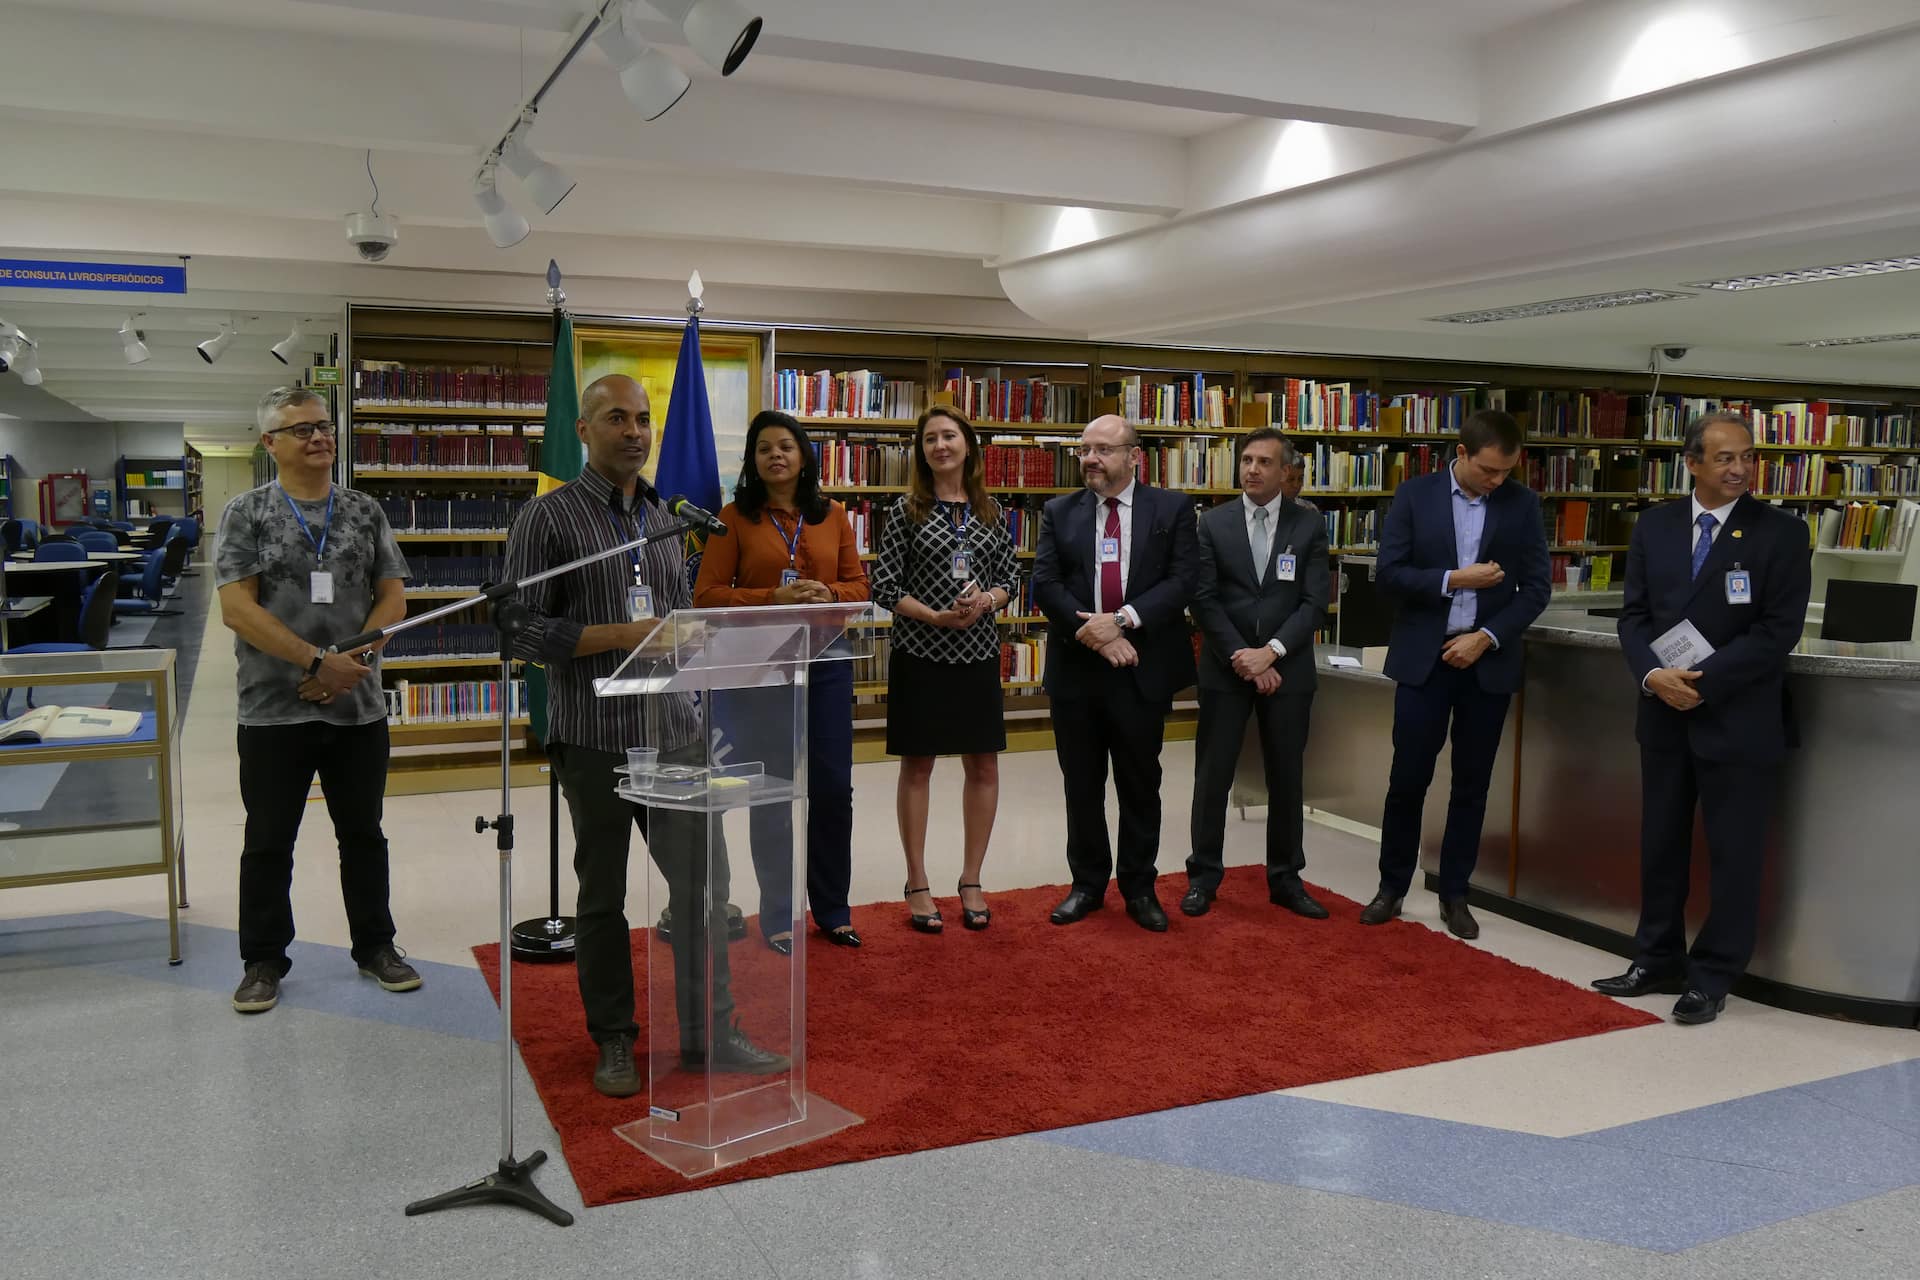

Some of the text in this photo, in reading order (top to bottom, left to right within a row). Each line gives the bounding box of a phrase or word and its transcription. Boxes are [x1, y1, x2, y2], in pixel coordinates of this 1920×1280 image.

[0, 269, 164, 284] DE CONSULTA LIVROS/PERIÓDICOS
